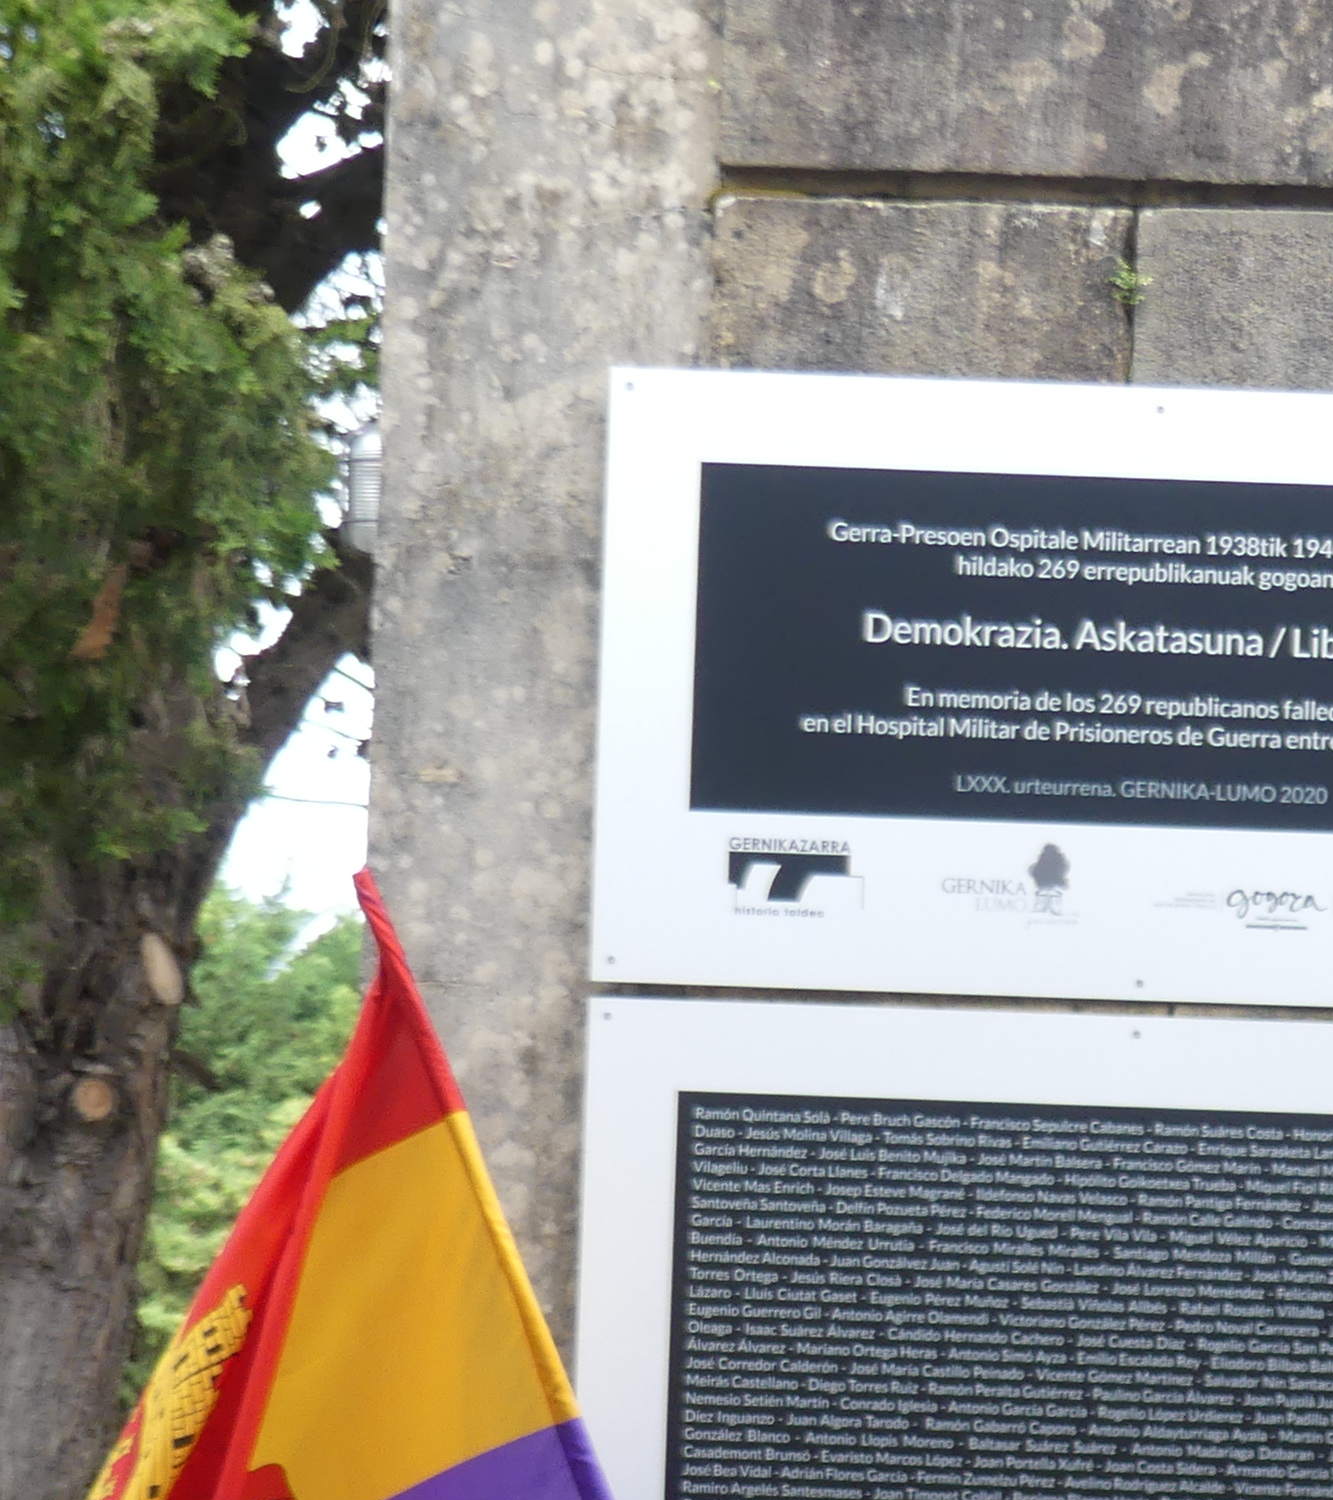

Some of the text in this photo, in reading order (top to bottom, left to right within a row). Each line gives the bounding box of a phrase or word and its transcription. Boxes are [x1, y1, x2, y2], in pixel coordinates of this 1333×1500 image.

[832, 521, 985, 547] Gerra-Presoen
[990, 527, 1078, 554] Ospitale
[1083, 530, 1200, 555] Militarrean
[1206, 535, 1287, 558] 1938tik
[957, 555, 1034, 578] hildako
[1037, 558, 1079, 580] 269
[1083, 559, 1254, 589] errepublikanuak
[865, 611, 1069, 650] Demokrazia.
[1076, 619, 1263, 657] Askatasuna
[1268, 625, 1286, 658] /
[907, 686, 933, 708] En
[938, 687, 1030, 711] memoria
[1034, 691, 1061, 712] de
[1066, 692, 1095, 713] los
[1099, 693, 1141, 715] 269
[1146, 695, 1279, 723] republicanos
[803, 717, 828, 733] en
[834, 713, 851, 734] el
[856, 714, 944, 741] Hospital
[949, 717, 1019, 740] Militar
[1024, 720, 1050, 741] de
[1055, 721, 1173, 745] Prisioneros
[1177, 725, 1203, 746] de
[1207, 726, 1281, 749] Guerra
[956, 775, 1328, 805] LXXX. urteurrena. GERNIKA-LUMO 2020
[729, 837, 851, 854] GERNIKAZARRA
[942, 878, 1027, 896] GERNIKA
[695, 1107, 738, 1121] Ramón
[742, 1109, 801, 1125] Quintana
[841, 1112, 870, 1125] Pere
[694, 1125, 734, 1138] Duaso
[745, 1127, 780, 1140] Jesús
[694, 1143, 735, 1156] García
[739, 1144, 807, 1159] Hernández
[818, 1147, 847, 1160] José
[692, 1178, 814, 1194] Vicente Mas Enrich
[690, 1267, 729, 1281] Torres
[734, 1269, 778, 1285] Ortega
[686, 1356, 714, 1369] José
[718, 1357, 776, 1371] Corredor
[748, 1429, 790, 1443] Blanco
